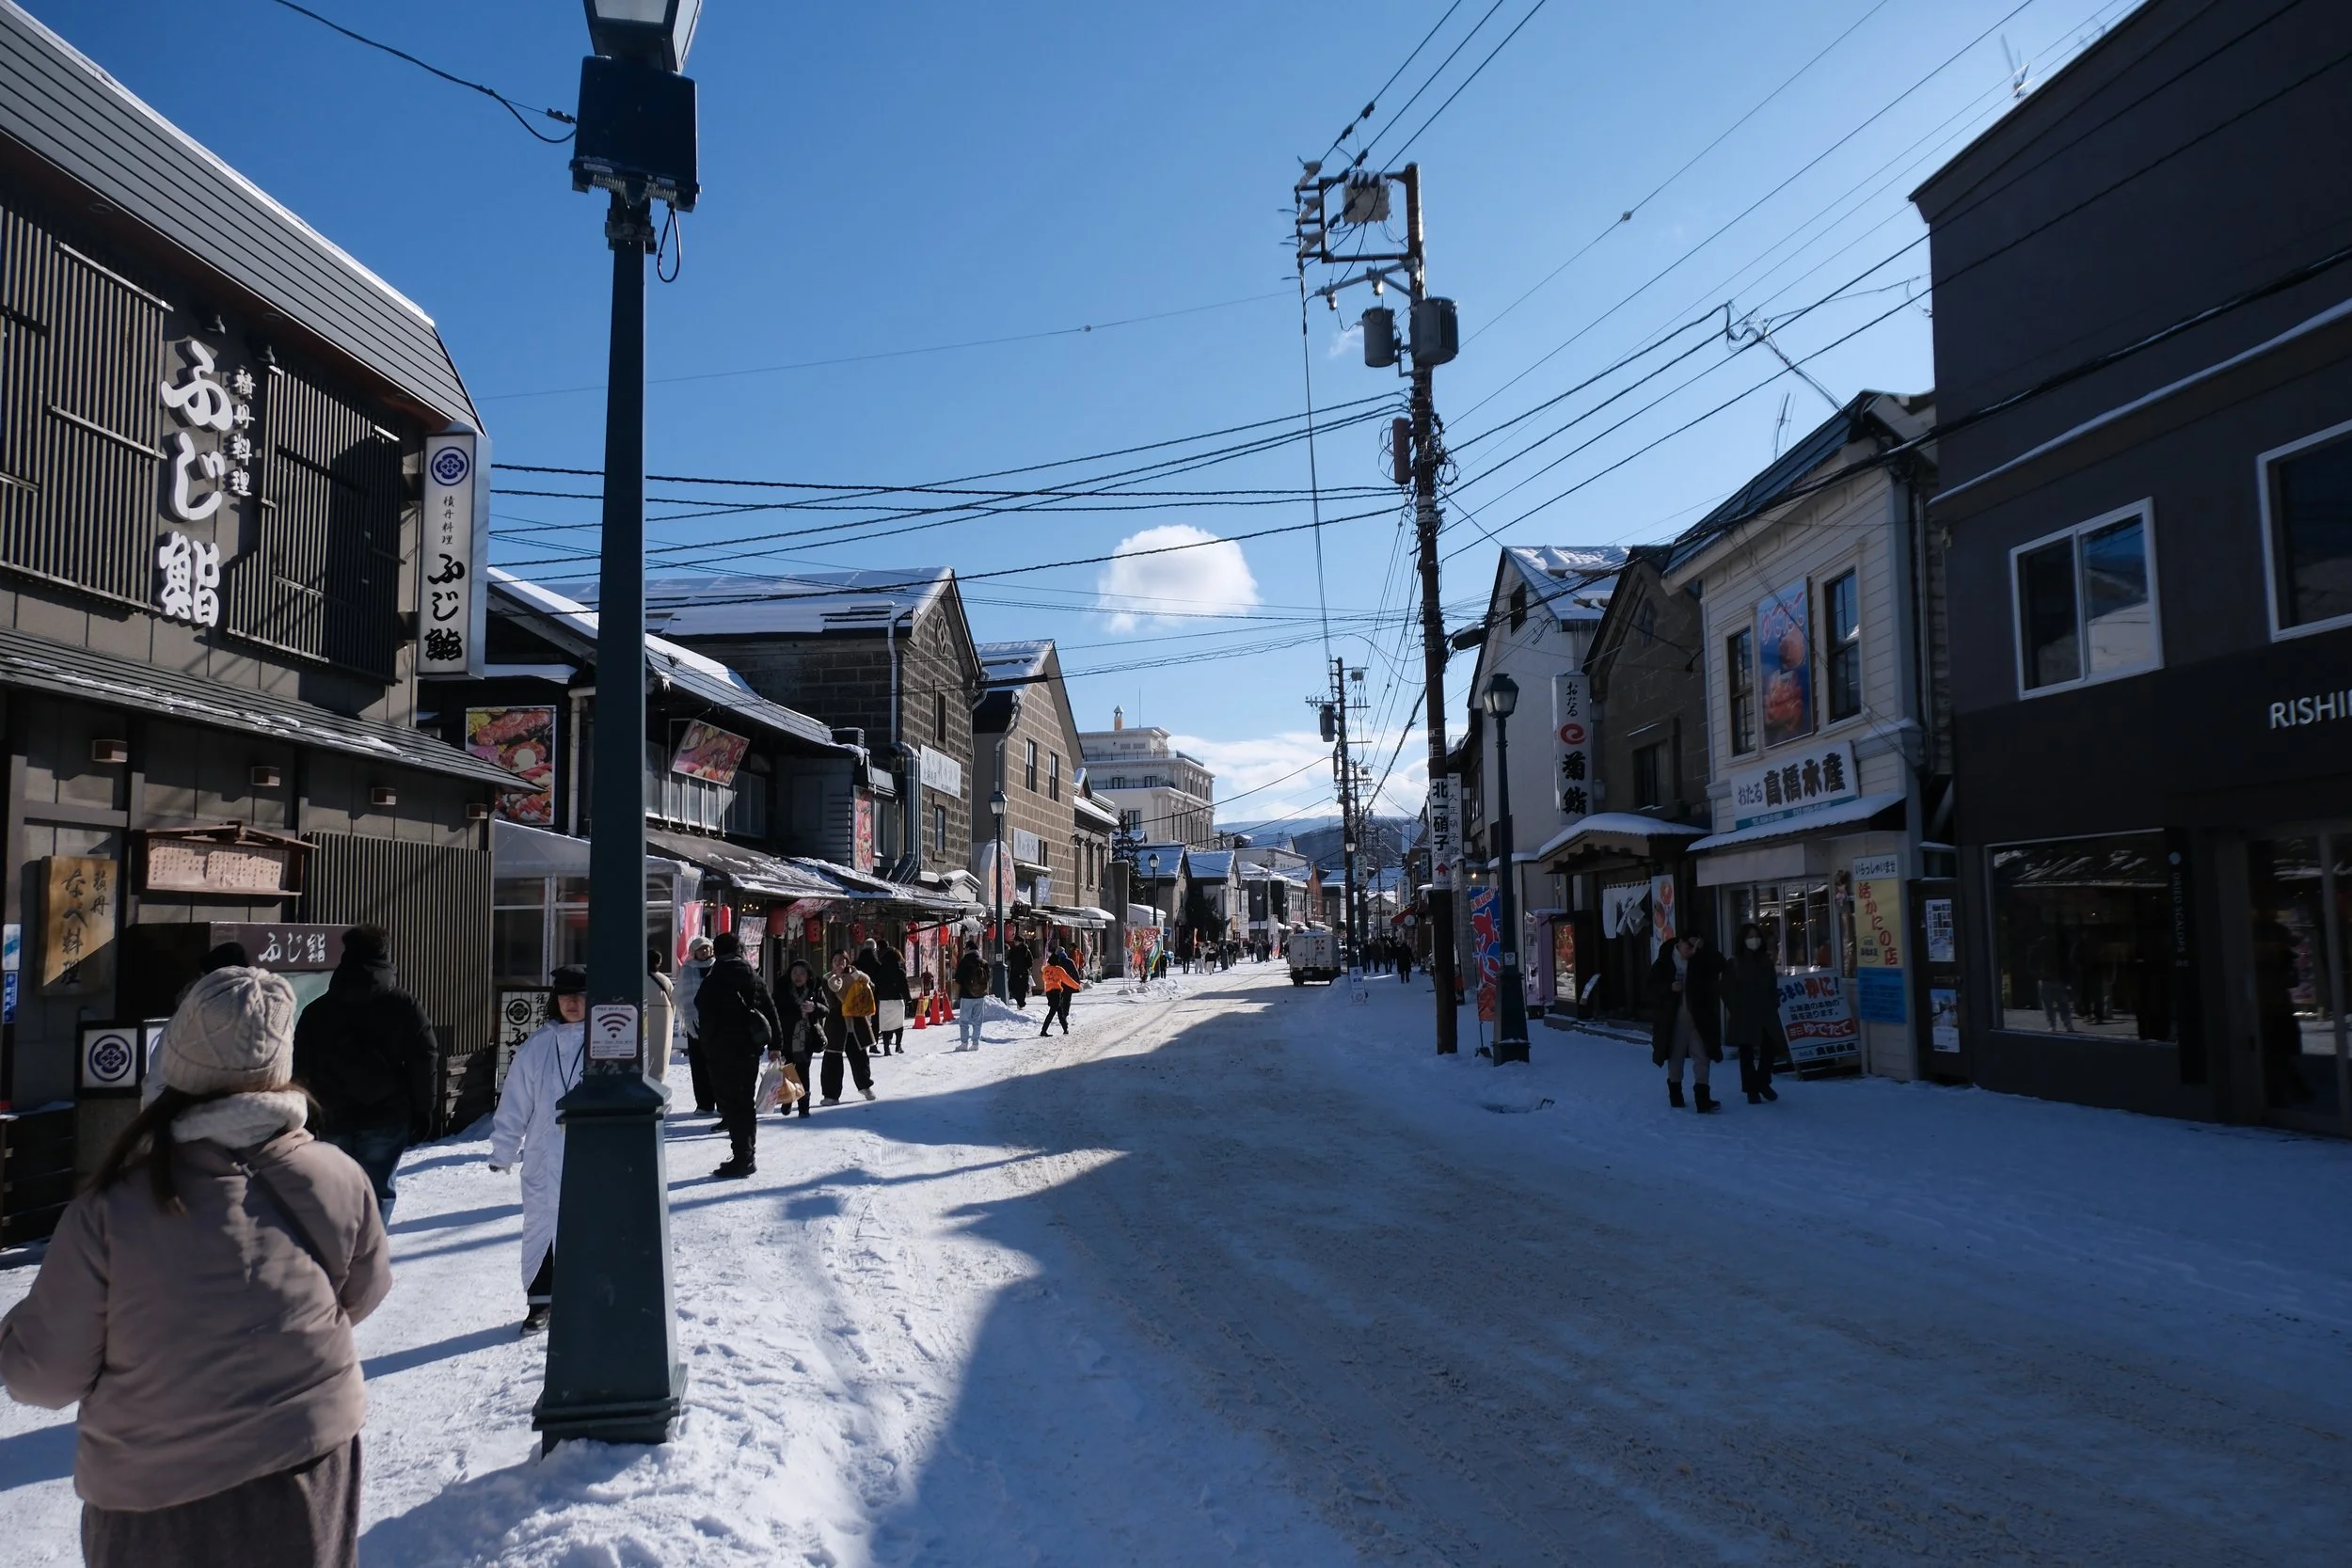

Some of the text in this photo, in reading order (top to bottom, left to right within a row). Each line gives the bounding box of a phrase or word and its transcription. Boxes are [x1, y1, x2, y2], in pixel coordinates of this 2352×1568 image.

[228, 365, 257, 498] 積丹料理
[159, 340, 234, 627] ふじ鮨
[440, 494, 457, 547] 積丹料理
[423, 552, 466, 662] ふじ鮨
[1566, 680, 1579, 718] おたる
[2269, 689, 2352, 730] RISHI
[1432, 781, 1450, 852] 北一硝子
[1738, 782, 1763, 806] おたる
[257, 931, 326, 964] ふじ鮨
[1857, 881, 1899, 967] 活かにの店
